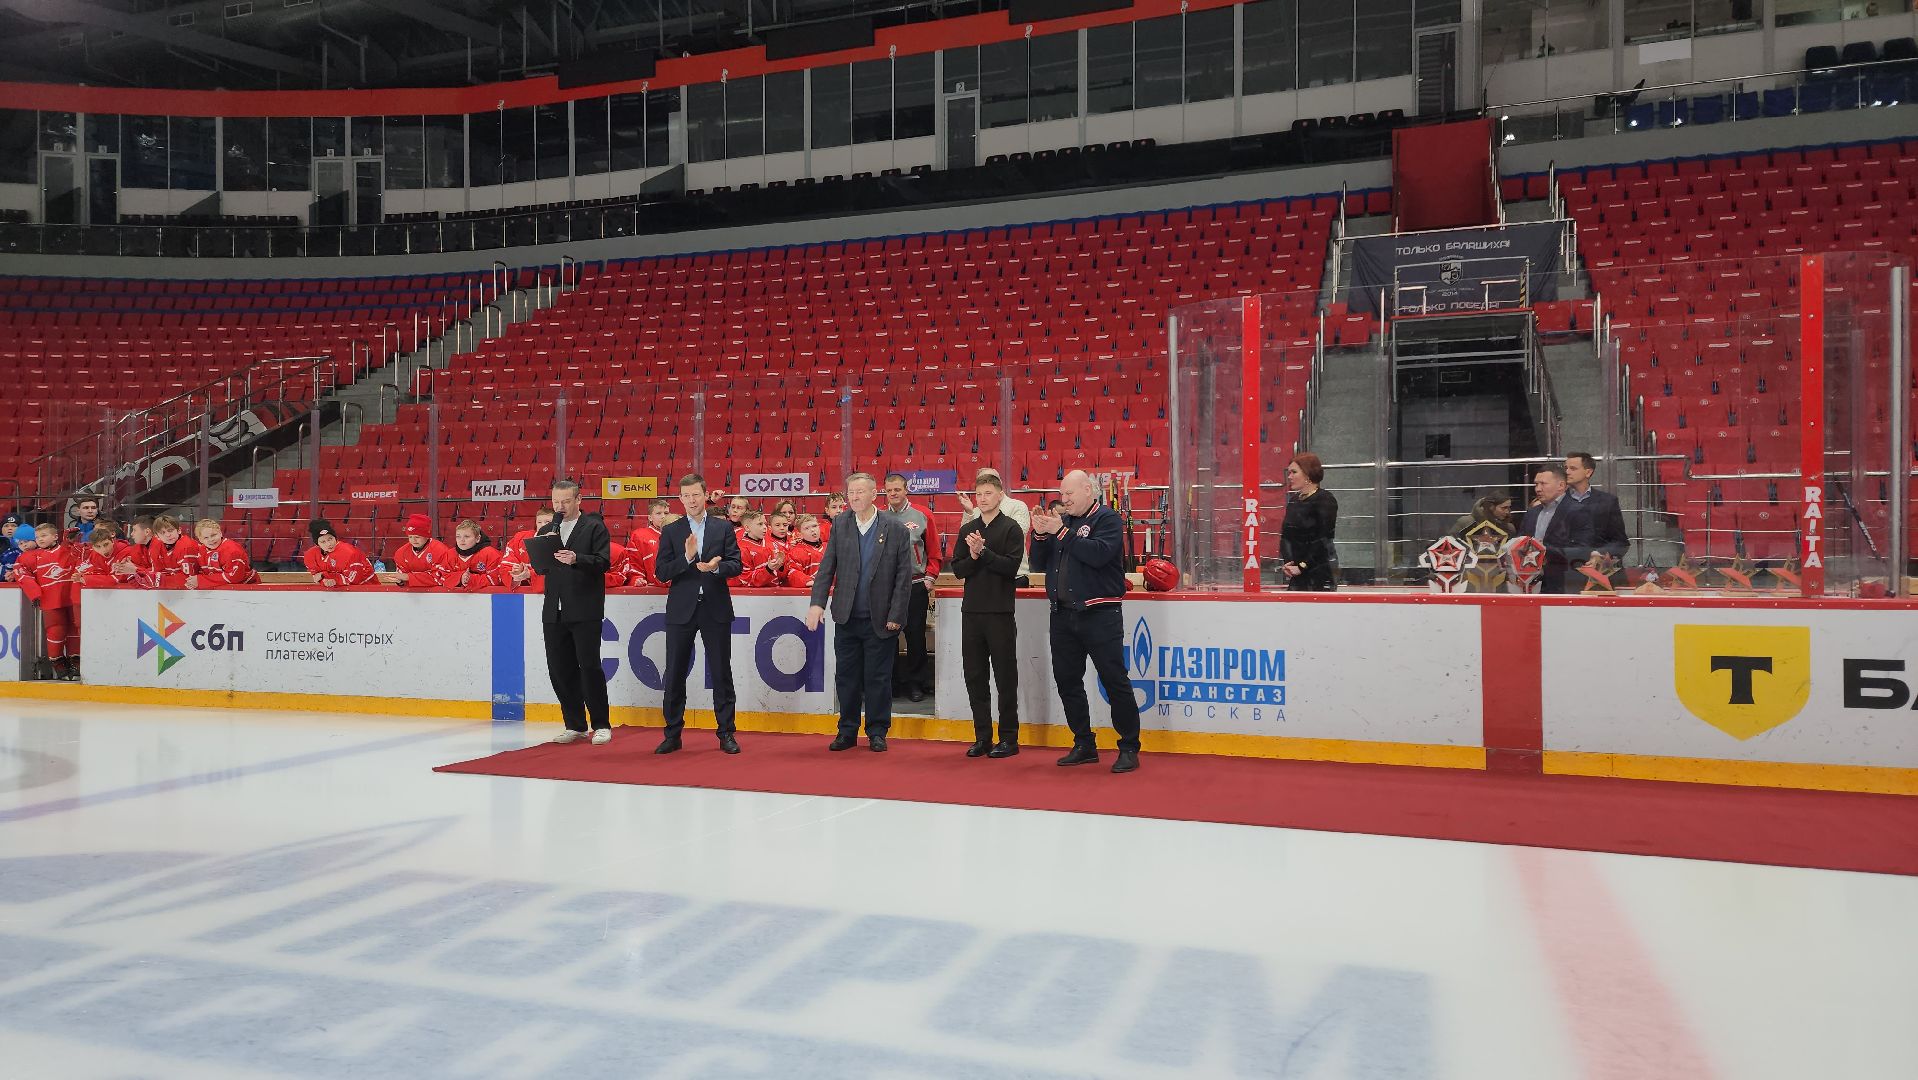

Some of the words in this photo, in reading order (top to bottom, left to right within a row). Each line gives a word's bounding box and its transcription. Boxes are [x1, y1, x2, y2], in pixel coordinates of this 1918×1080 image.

[1395, 244, 1440, 256] ТОЛЬКО
[474, 485, 521, 497] KHL.RU
[623, 483, 652, 492] БАНК
[745, 477, 804, 492] согаз
[351, 491, 397, 499] OLIMPBET
[1244, 498, 1259, 569] RAITA
[1804, 486, 1822, 569] RAITA
[191, 623, 244, 651] сбп
[266, 630, 324, 643] система
[328, 628, 393, 648] быстрых
[266, 646, 334, 662] платежей
[1158, 646, 1286, 681] ГАЗПРОМ
[1711, 655, 1773, 705] Т
[1843, 658, 1918, 711] Б
[1161, 684, 1283, 703] ТРАНСГАЗ
[1158, 704, 1287, 723] МОСКВА
